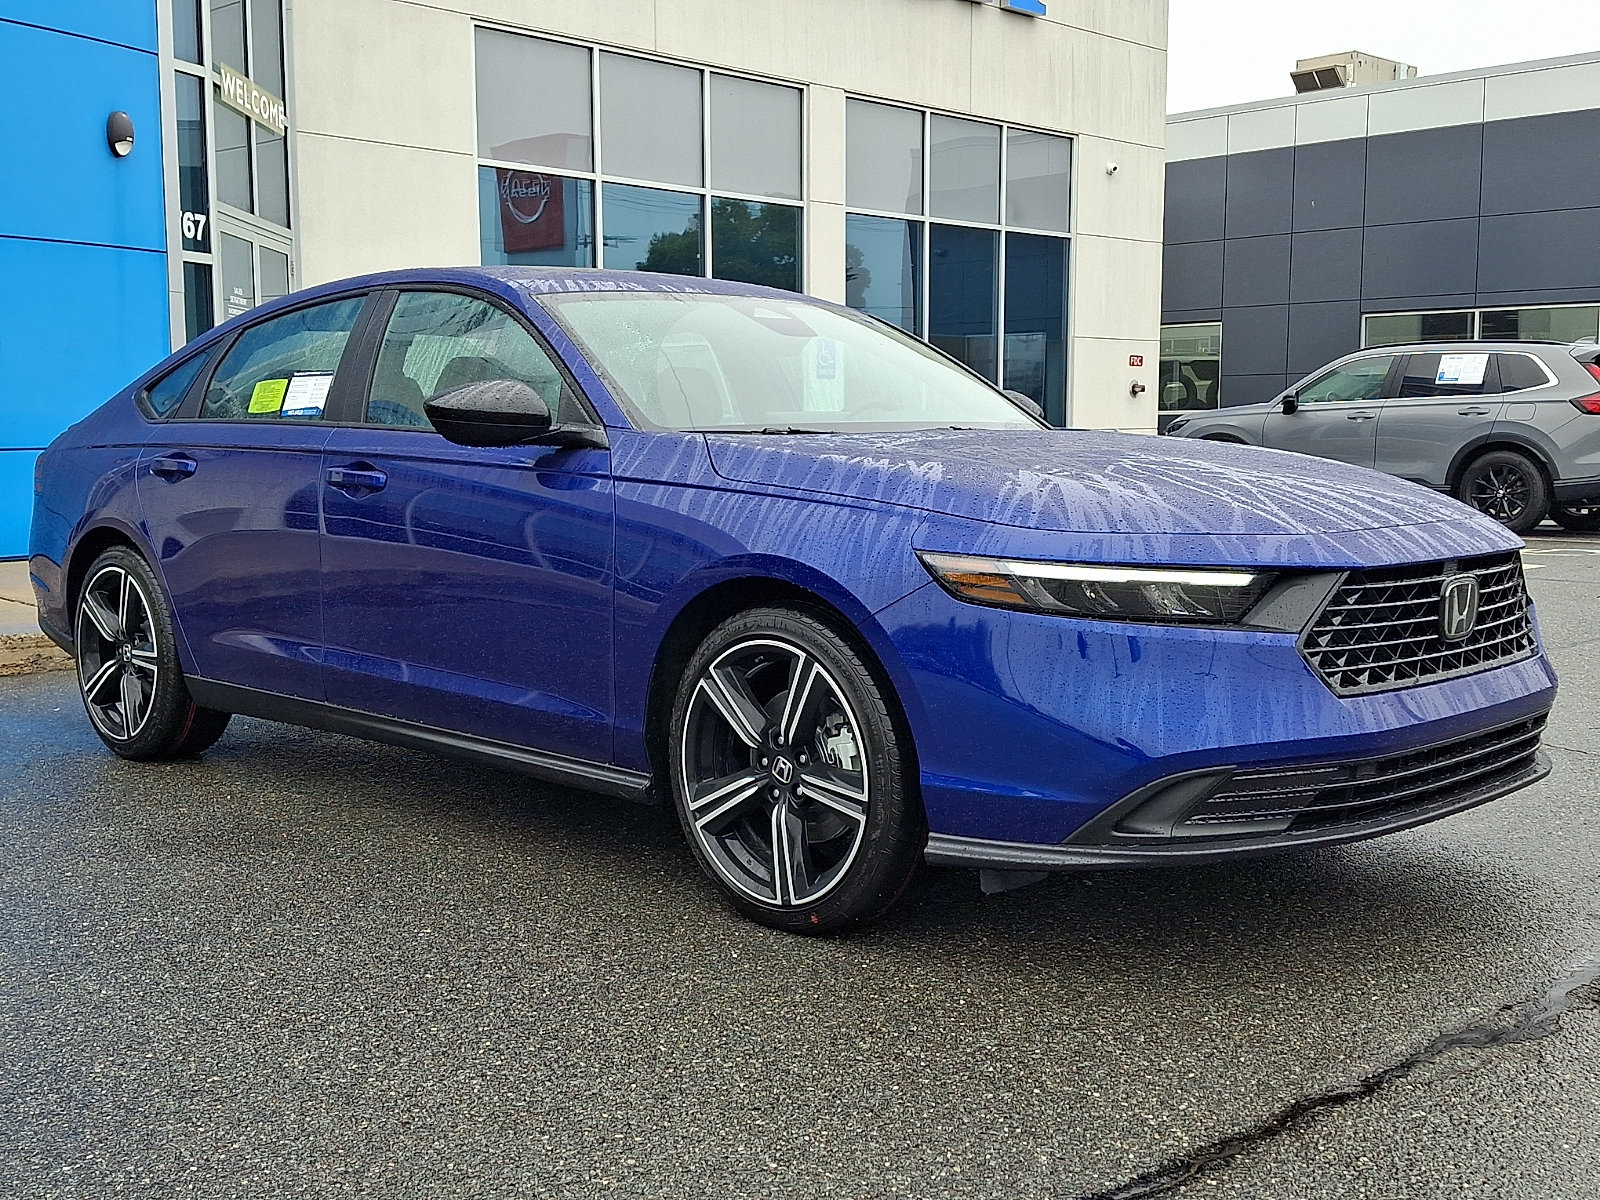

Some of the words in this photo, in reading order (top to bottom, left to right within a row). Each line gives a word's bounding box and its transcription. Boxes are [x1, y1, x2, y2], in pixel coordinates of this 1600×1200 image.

[220, 68, 285, 131] WELCOME
[180, 211, 207, 241] 67
[1130, 356, 1142, 366] FDC
